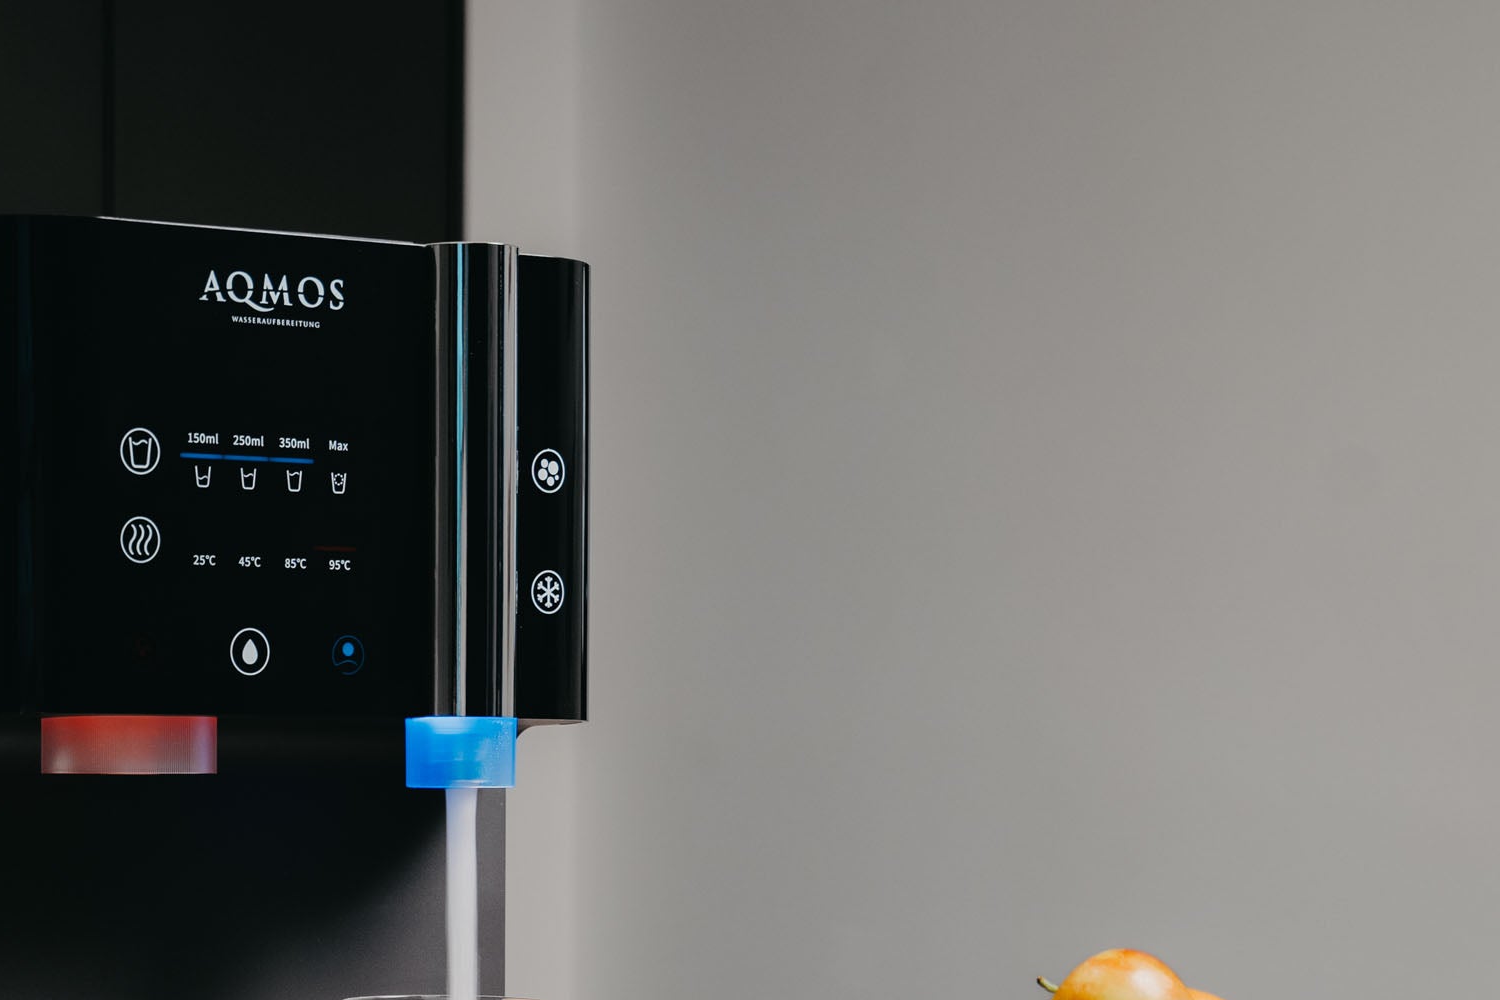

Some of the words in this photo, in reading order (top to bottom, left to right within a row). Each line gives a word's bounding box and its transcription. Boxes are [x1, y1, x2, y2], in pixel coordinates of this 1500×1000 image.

[199, 269, 345, 312] AQMOS
[231, 315, 321, 329] WASSERAUFBEREITUNG
[187, 432, 219, 445] 150ml
[232, 434, 265, 448] 250ml
[278, 437, 310, 450] 350ml
[328, 439, 349, 452] Max
[192, 554, 217, 567] 25°C
[238, 556, 262, 568] 45°C
[284, 557, 307, 570] 85°C
[328, 559, 351, 571] 95°C
